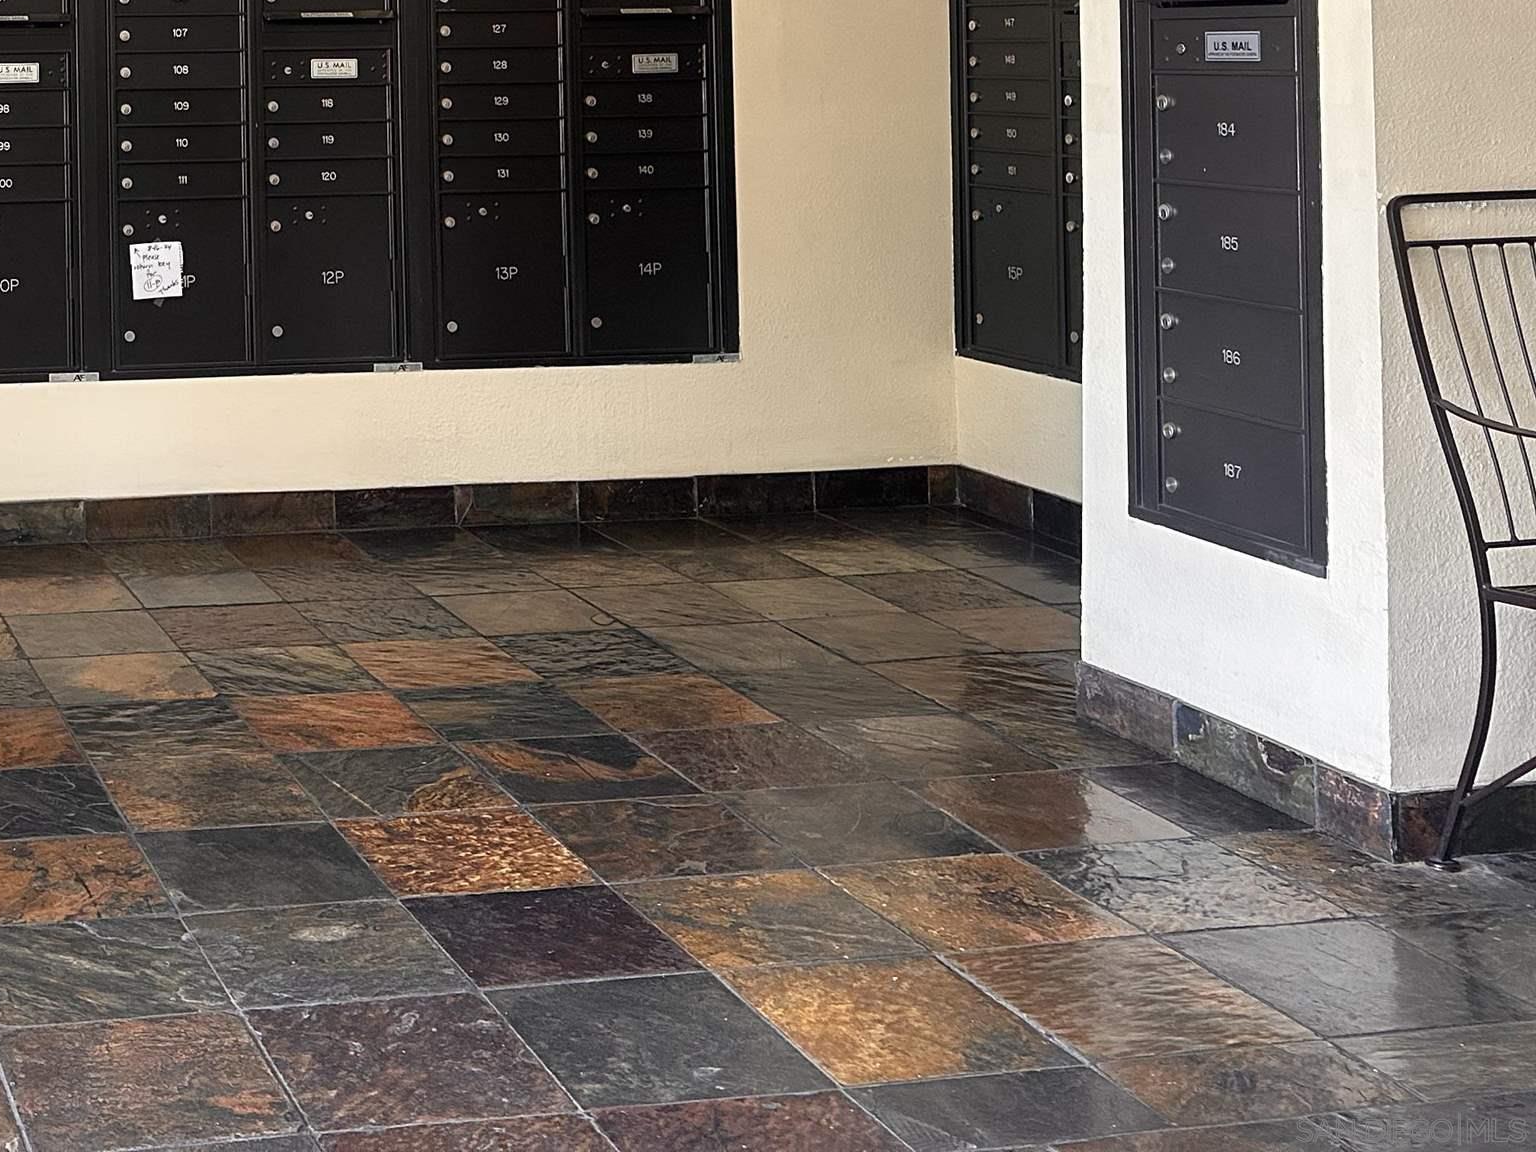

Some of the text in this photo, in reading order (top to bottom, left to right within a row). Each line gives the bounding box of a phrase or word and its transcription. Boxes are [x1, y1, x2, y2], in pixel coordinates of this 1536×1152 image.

[172, 27, 188, 38] 107
[492, 23, 507, 34] 127
[1214, 41, 1252, 51] U.S. MAIL
[13, 66, 33, 74] MAIL
[173, 64, 189, 75] 108
[332, 61, 352, 69] MAIL
[492, 60, 508, 70] 128
[321, 98, 334, 108] 118
[493, 95, 509, 106] 129
[637, 93, 653, 104] 138
[173, 101, 190, 111] 109
[638, 128, 653, 139] 139
[1216, 122, 1236, 137] 184
[175, 138, 189, 148] 110
[321, 134, 335, 145] 119
[493, 132, 510, 143] 130
[497, 168, 510, 179] 131
[638, 164, 655, 175] 140
[178, 175, 188, 185] 111
[321, 171, 337, 181] 120
[1220, 235, 1239, 251] 185
[495, 266, 519, 281] 13P
[638, 262, 662, 276] 14P
[1007, 265, 1023, 281] 15P
[181, 274, 196, 288] 1P
[321, 270, 345, 285] 12P
[1222, 348, 1241, 366] 186
[1223, 463, 1242, 479] 187
